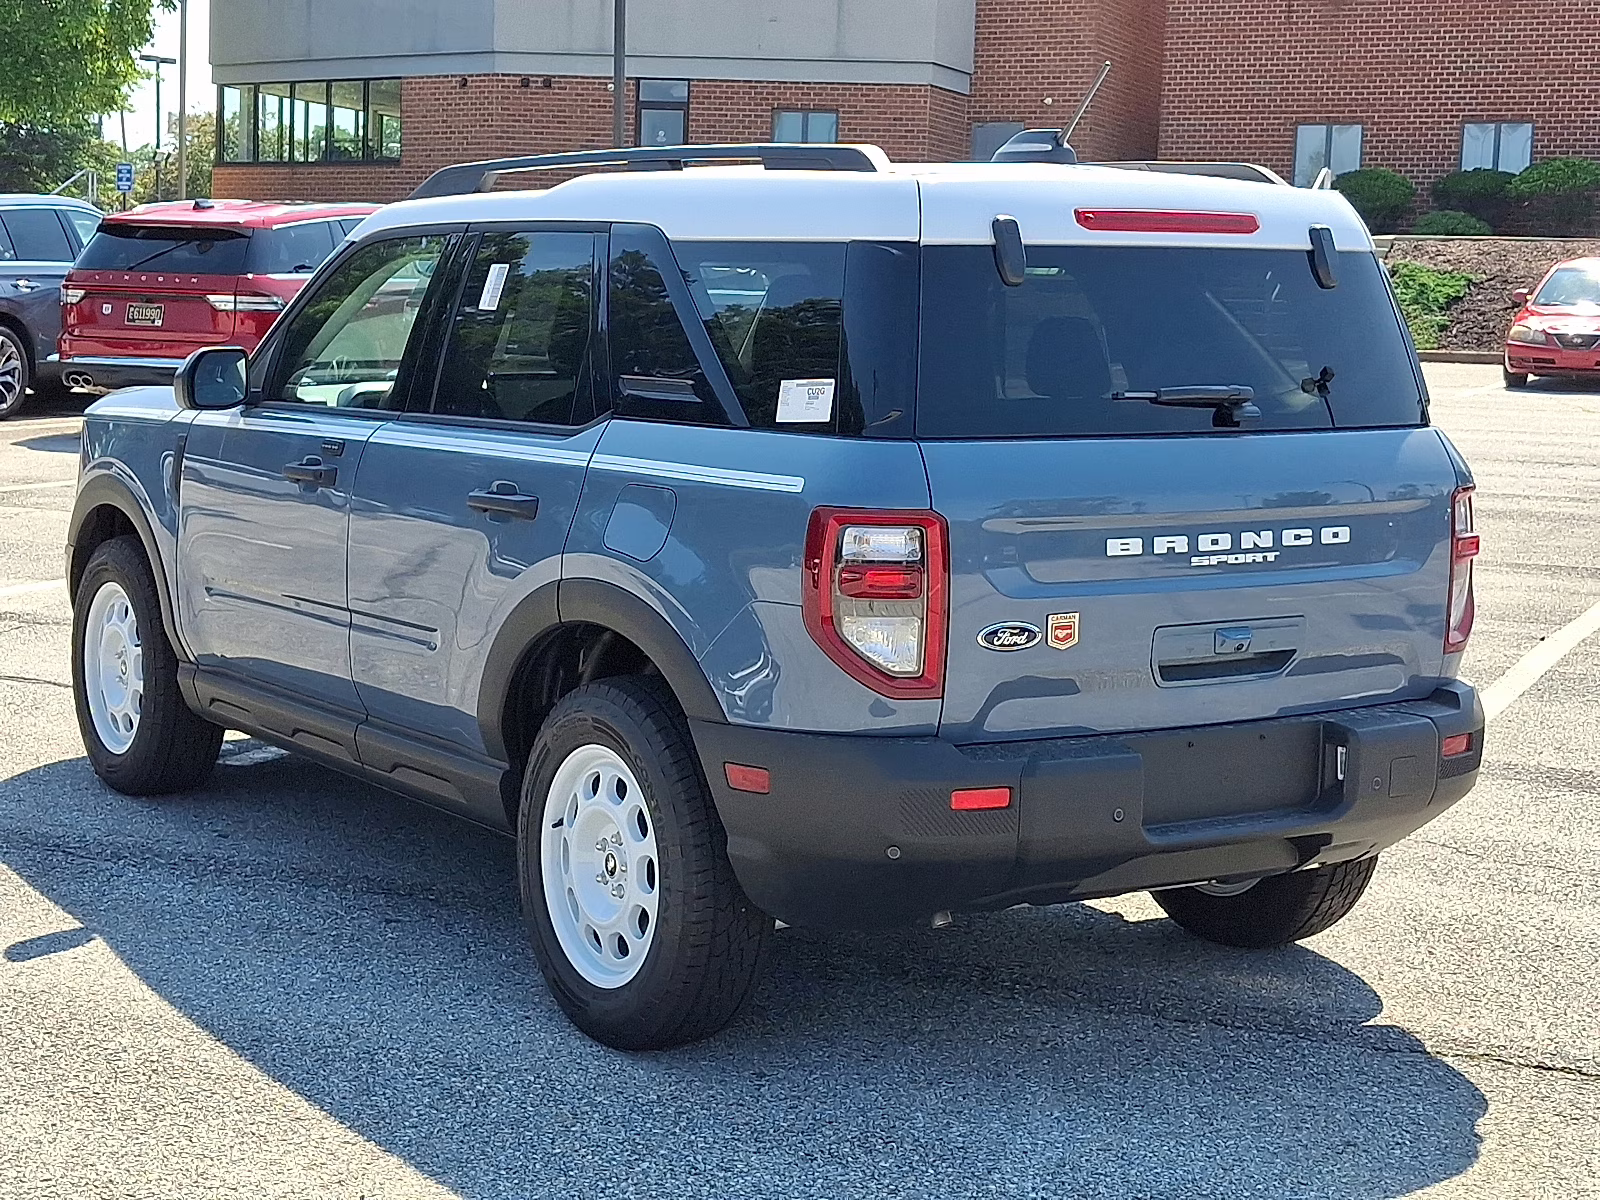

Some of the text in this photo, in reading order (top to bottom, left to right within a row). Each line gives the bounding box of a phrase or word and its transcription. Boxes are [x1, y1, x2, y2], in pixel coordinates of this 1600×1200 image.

[95, 274, 198, 283] LINCOLN
[1106, 526, 1351, 557] BRONCO
[1190, 551, 1280, 567] SPORT
[1050, 614, 1077, 622] CARMAN
[993, 628, 1029, 646] Ford
